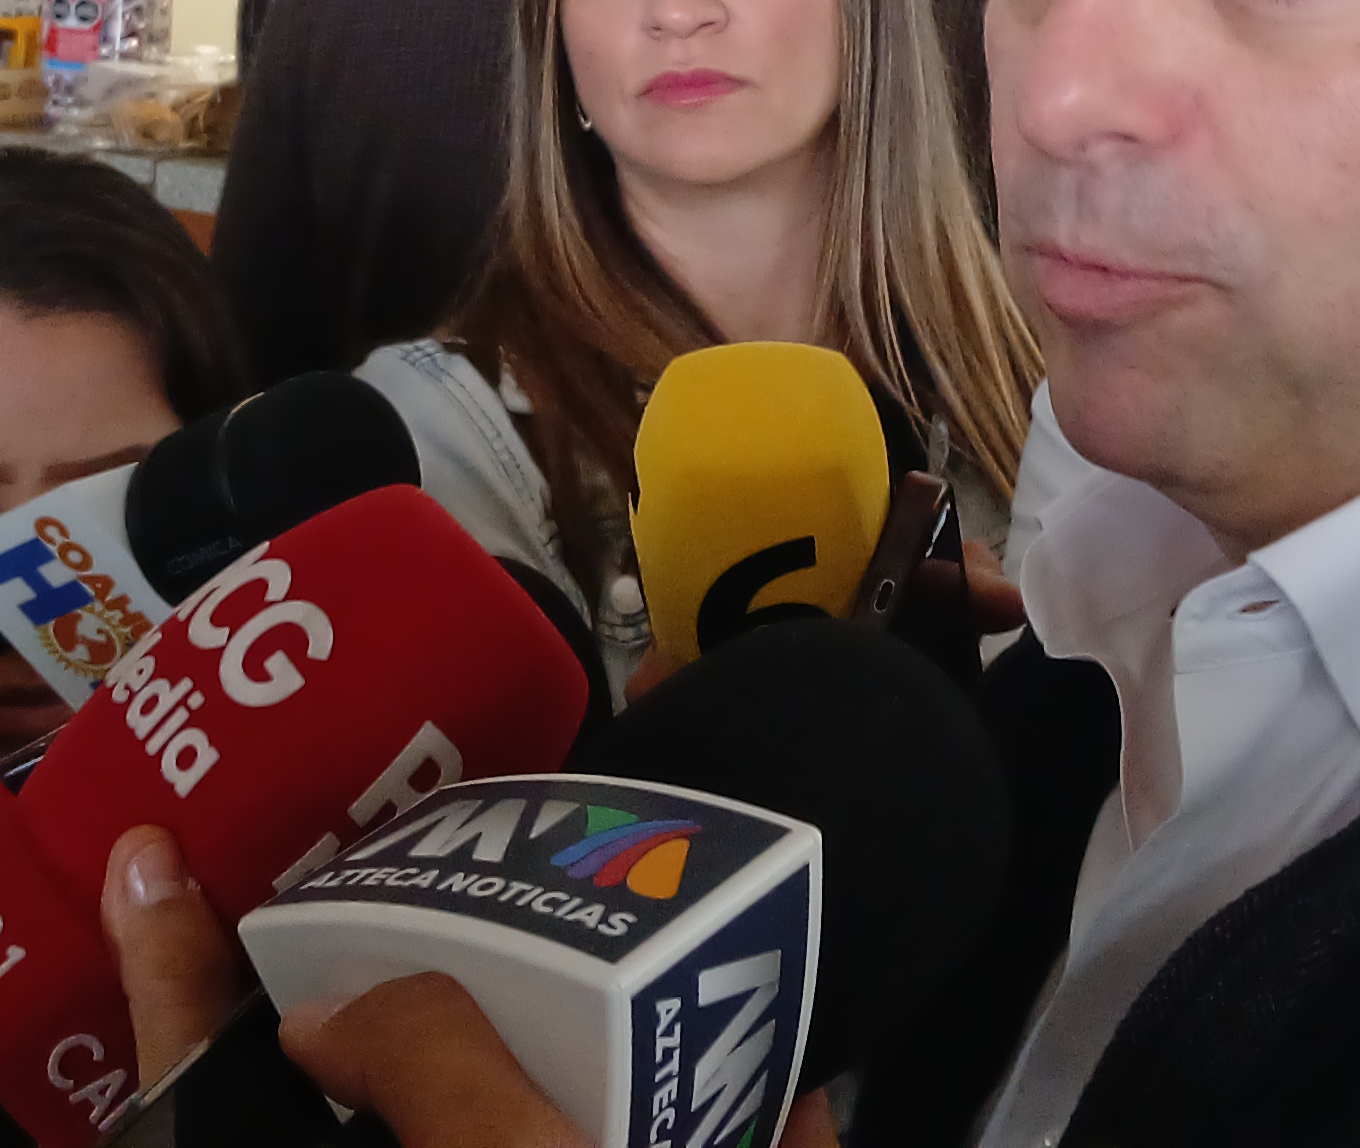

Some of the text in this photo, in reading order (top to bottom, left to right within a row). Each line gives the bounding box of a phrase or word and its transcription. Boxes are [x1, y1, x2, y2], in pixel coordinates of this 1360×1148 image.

[300, 867, 638, 937] AZTECA NOTICIAS
[650, 997, 681, 1148] AZTEC
